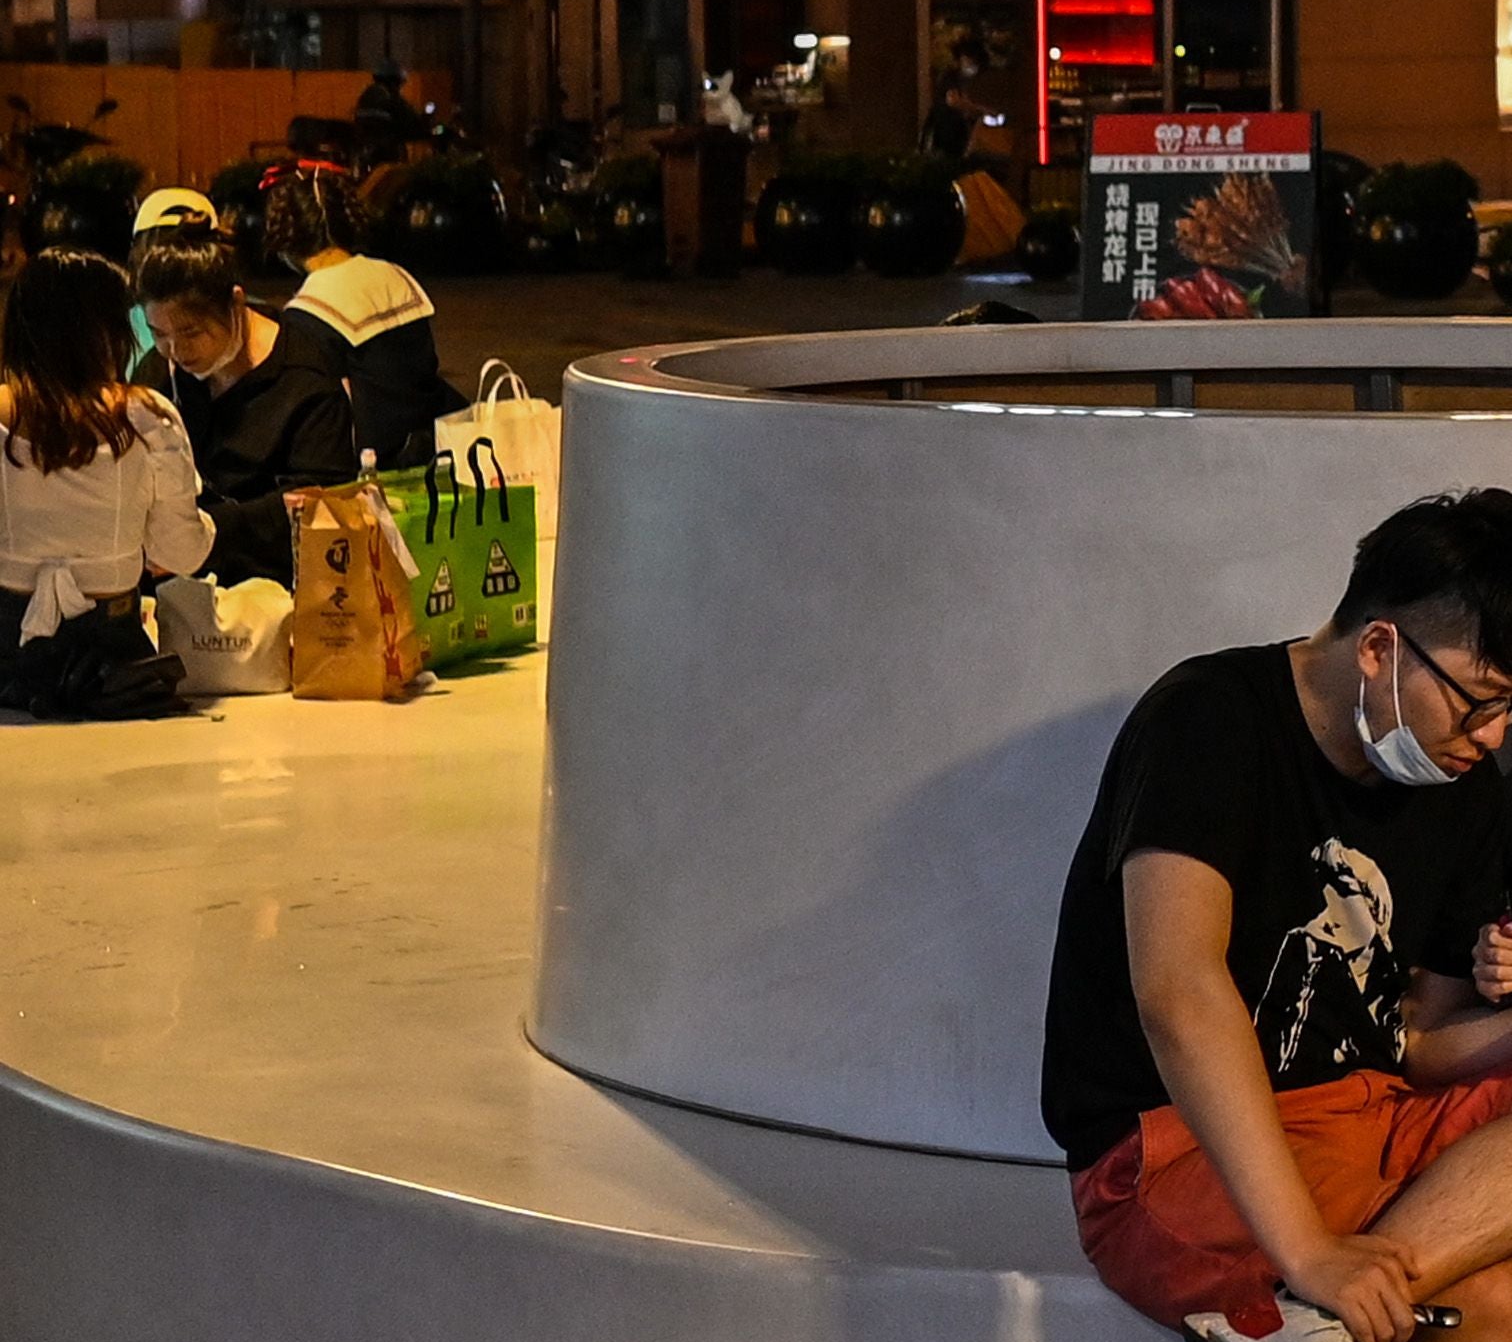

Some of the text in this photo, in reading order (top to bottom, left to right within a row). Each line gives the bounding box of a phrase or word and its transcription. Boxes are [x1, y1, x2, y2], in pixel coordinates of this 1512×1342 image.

[1109, 159, 1291, 171] JING DONG SHENG
[1102, 183, 1130, 283] 烧烤龙虾
[1133, 202, 1160, 301] 现已上市
